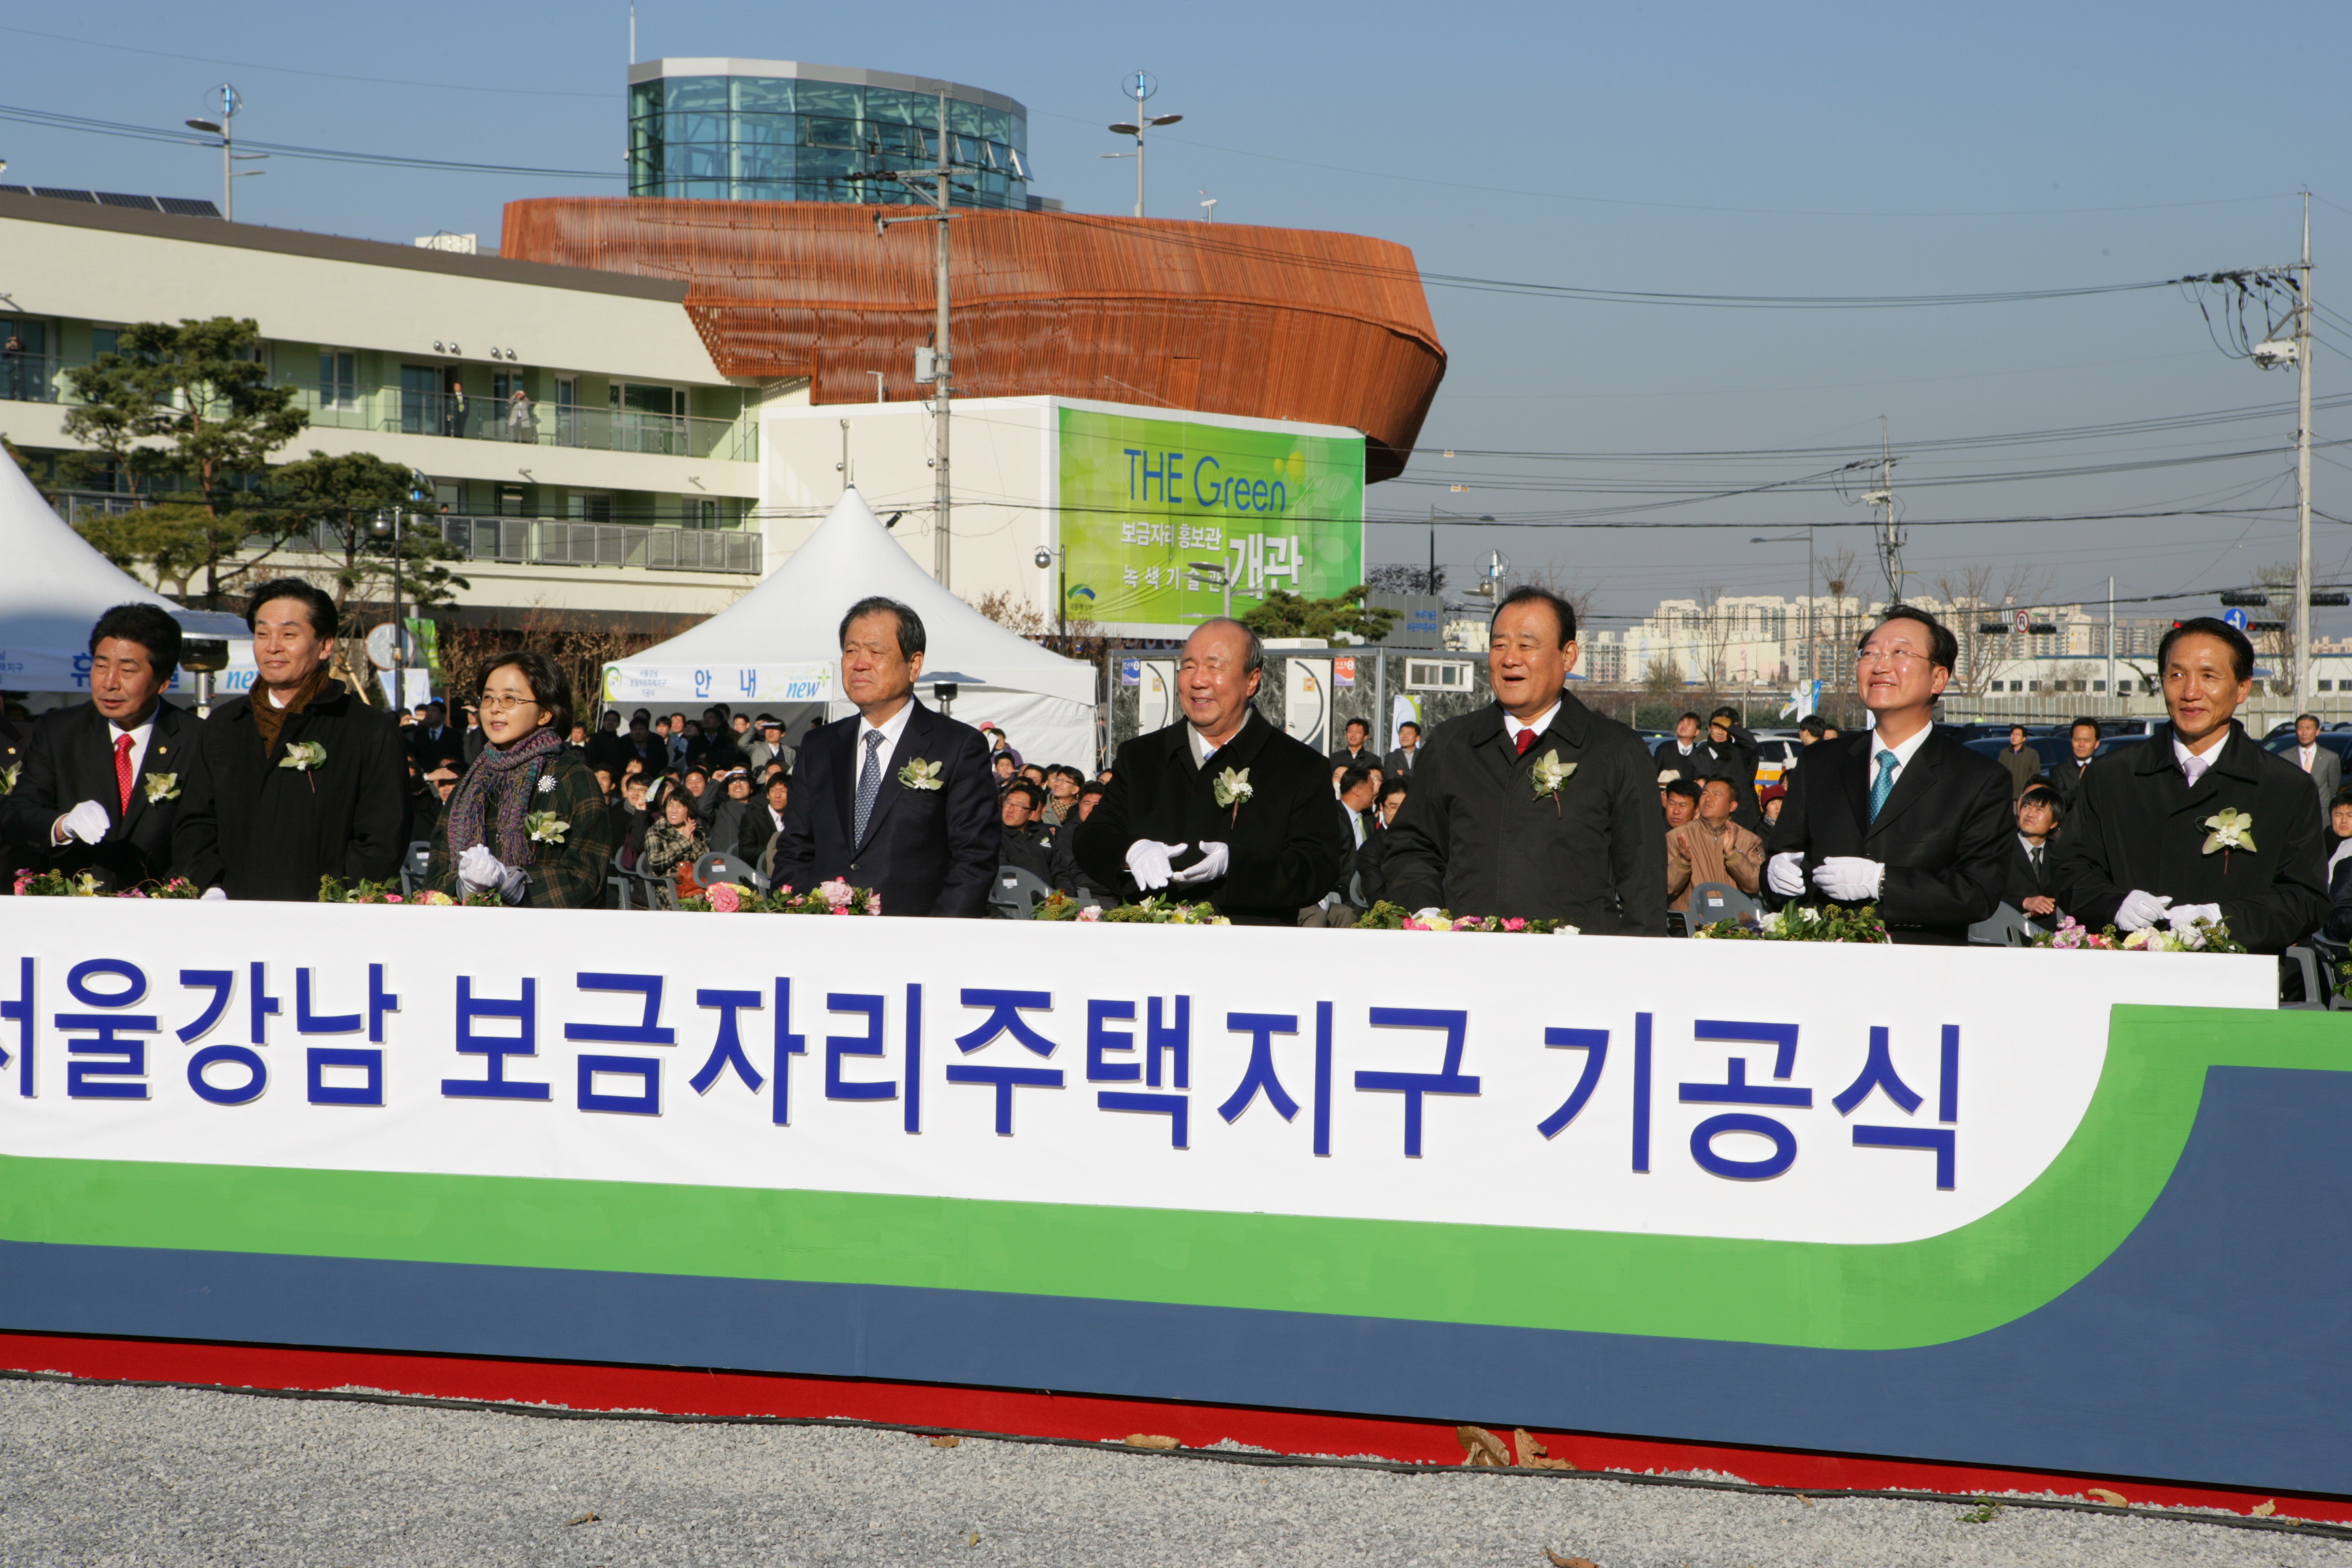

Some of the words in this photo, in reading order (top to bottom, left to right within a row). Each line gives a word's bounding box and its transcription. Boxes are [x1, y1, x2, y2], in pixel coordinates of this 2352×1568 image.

[1123, 448, 1184, 504] THE
[1194, 455, 1286, 512] Green
[1120, 521, 1175, 547] 보금자리
[1178, 523, 1222, 551] 홍보관
[1229, 532, 1303, 600] 개관
[640, 669, 659, 678] 서울강남
[641, 689, 655, 697] 기공식
[786, 681, 820, 698] new
[443, 973, 1478, 1154] 보금자리주택지구
[1539, 1013, 1957, 1187] 기공식
